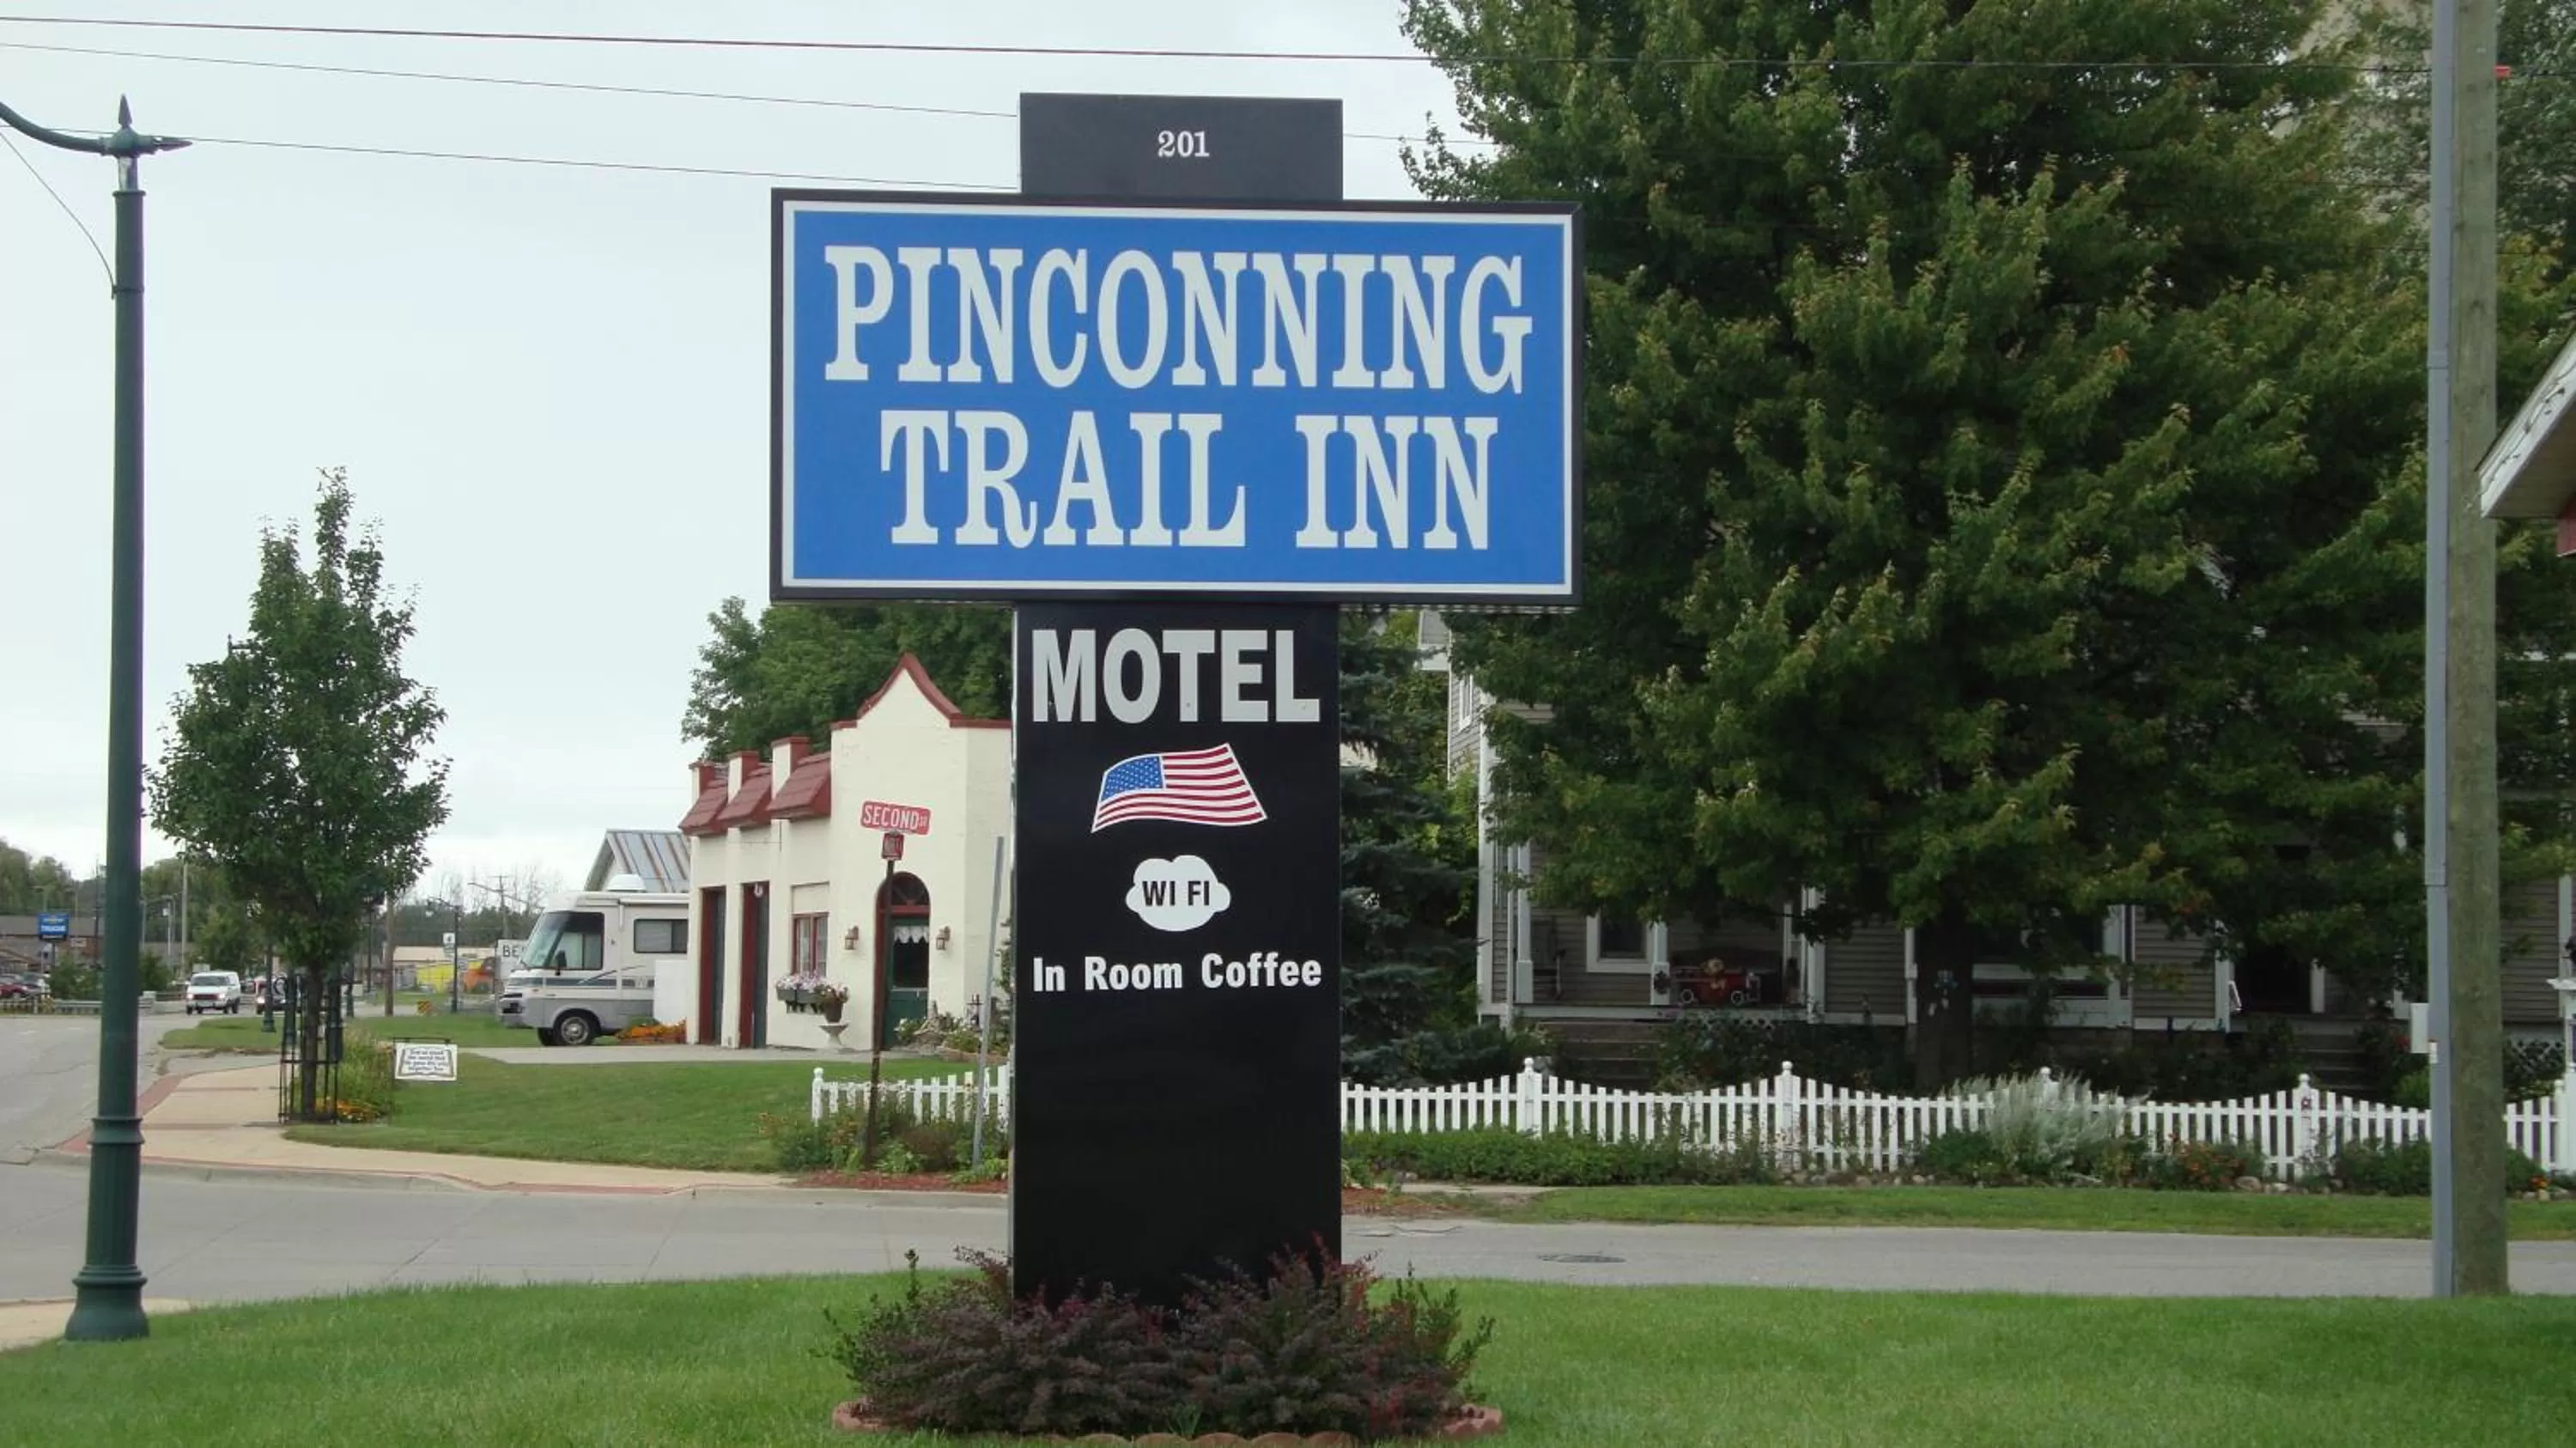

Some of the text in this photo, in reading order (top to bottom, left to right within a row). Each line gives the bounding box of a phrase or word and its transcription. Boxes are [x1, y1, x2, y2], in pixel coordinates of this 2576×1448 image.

[1157, 130, 1210, 158] 201
[824, 245, 1534, 395] PINCONNING
[880, 409, 1499, 551] TRAIL INN
[1031, 627, 1321, 725] MOTEL
[863, 804, 920, 830] SECOND
[1142, 879, 1211, 907] WI FI
[1032, 951, 1322, 992] In Room Coffee
